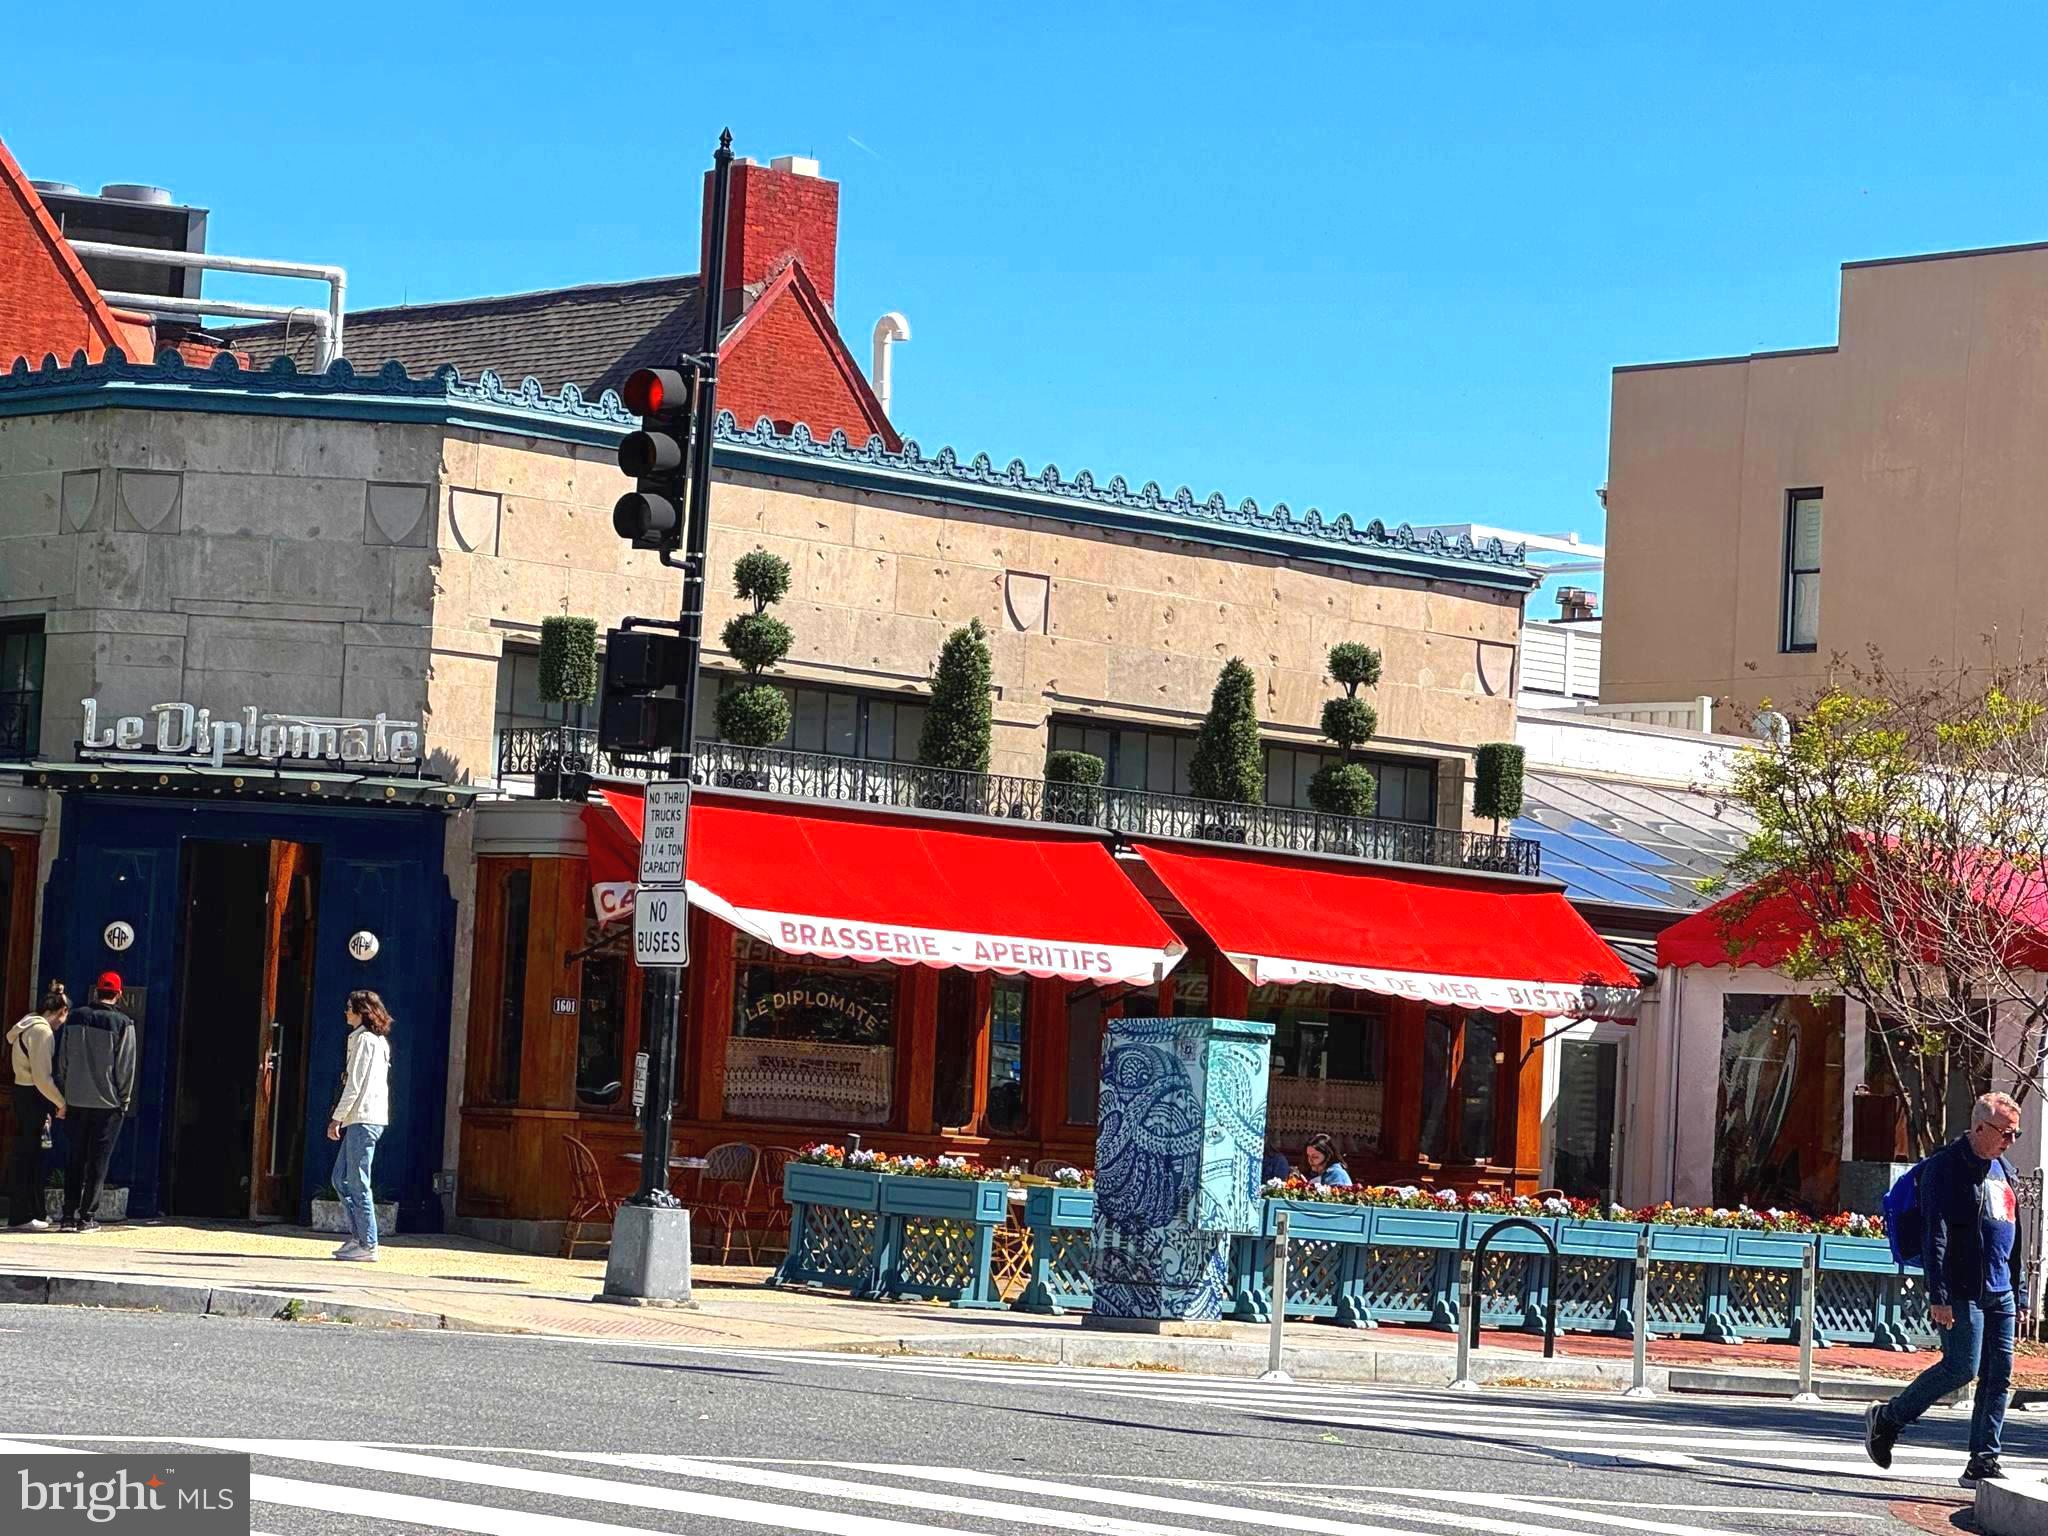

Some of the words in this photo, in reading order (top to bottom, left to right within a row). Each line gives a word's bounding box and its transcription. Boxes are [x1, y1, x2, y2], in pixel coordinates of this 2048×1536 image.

[81, 698, 143, 749] Le
[151, 702, 418, 767] Diplomate
[649, 791, 661, 804] NO
[664, 792, 685, 804] THRU
[651, 809, 682, 822] TRUCKS
[655, 826, 675, 839] OVER
[651, 843, 664, 857] 1/4
[668, 843, 683, 856] TON
[643, 861, 682, 874] CAPACITY
[649, 901, 668, 922] NO
[638, 931, 681, 954] BUSES
[780, 921, 940, 956] BRASSERIE
[975, 940, 1112, 973] APERITIFS
[1384, 977, 1422, 994] DE
[1430, 981, 1482, 1000] MER
[556, 1000, 575, 1013] 1601
[745, 998, 768, 1021] LE
[773, 989, 878, 1032] DIPLOMATE
